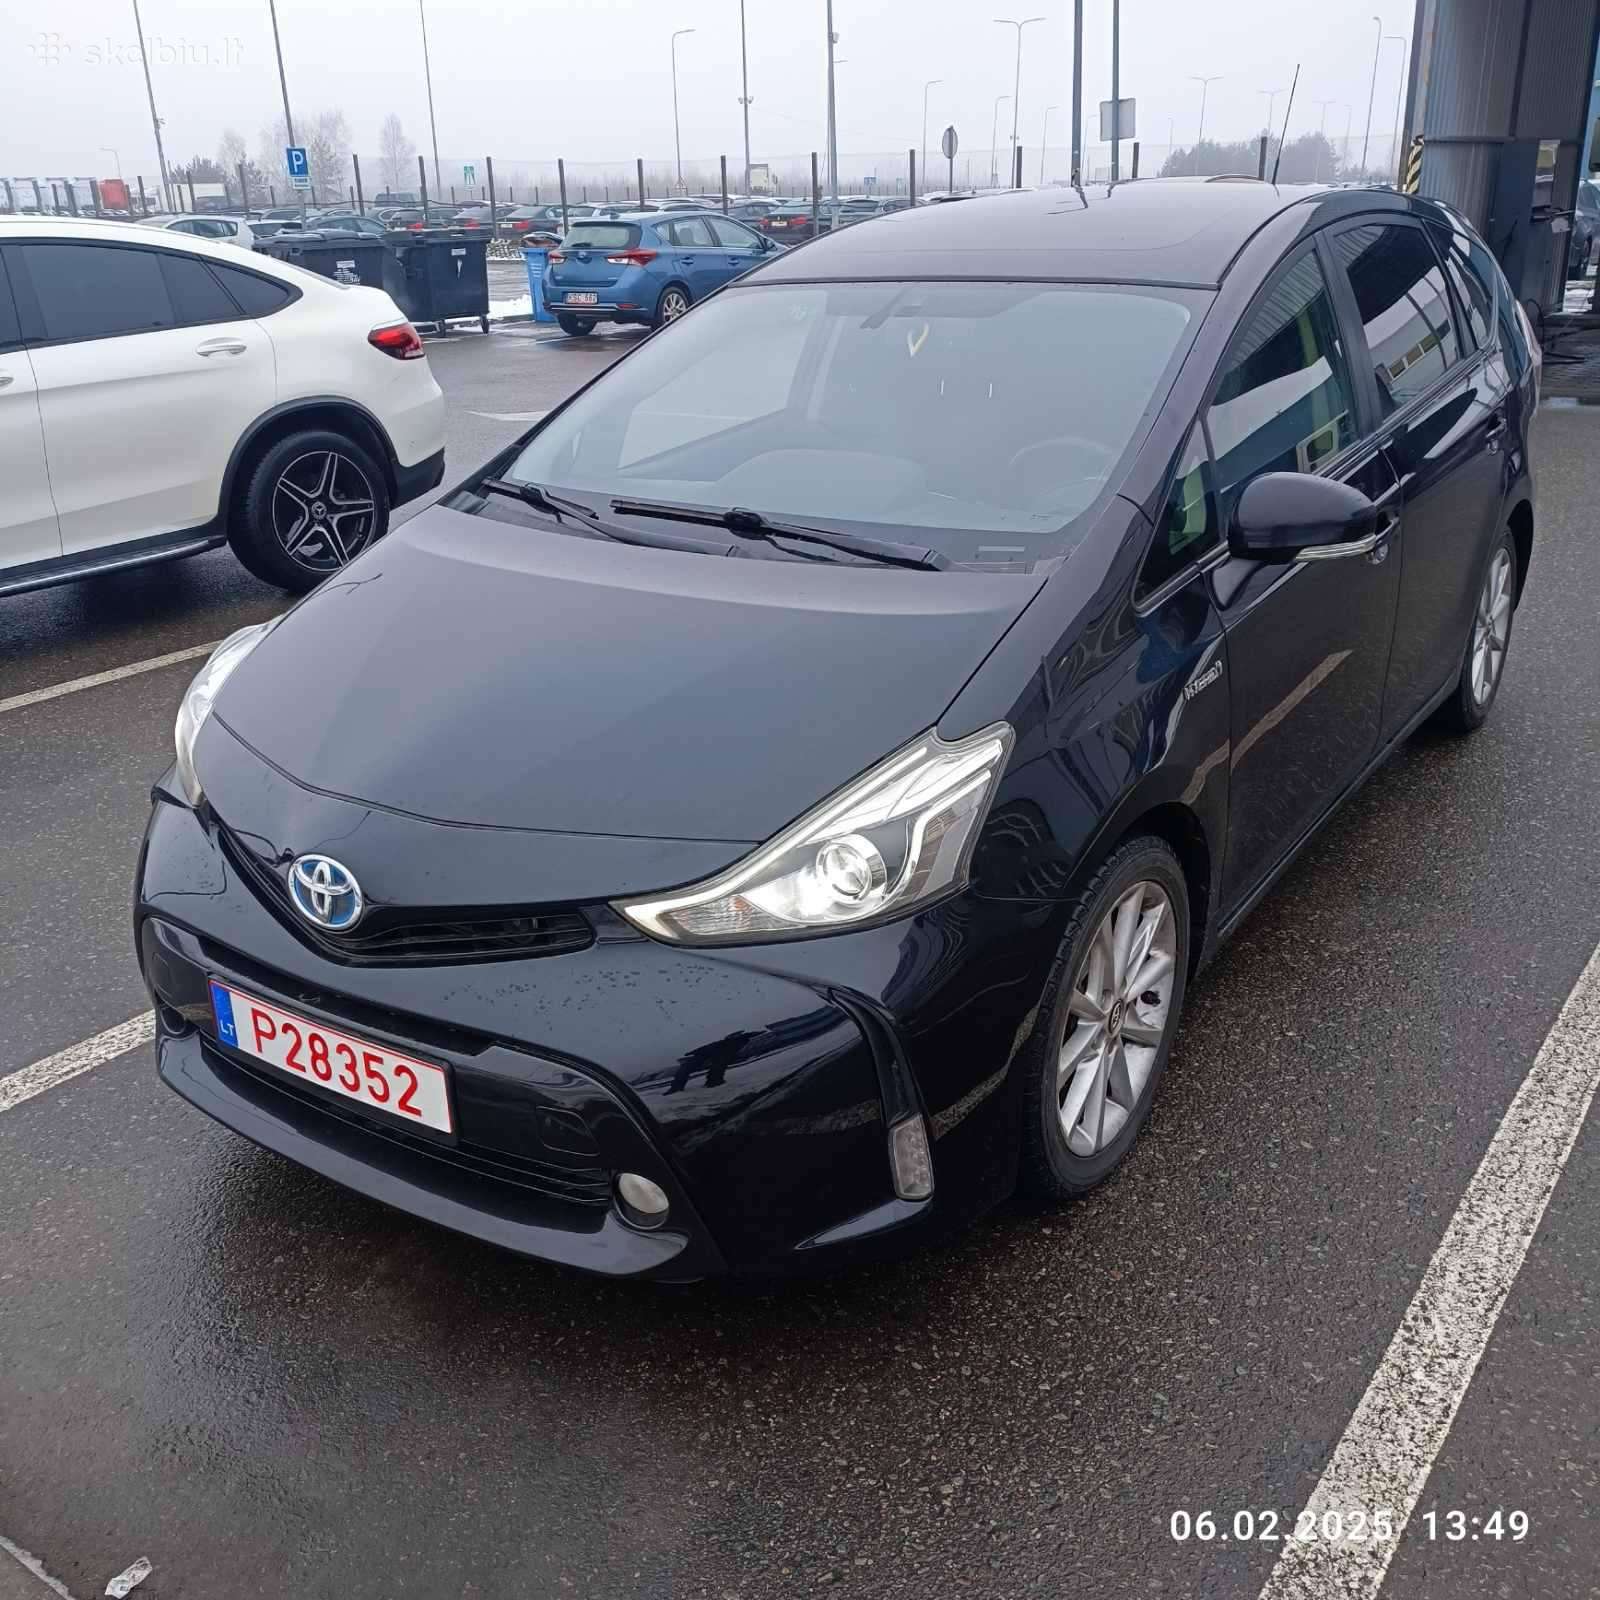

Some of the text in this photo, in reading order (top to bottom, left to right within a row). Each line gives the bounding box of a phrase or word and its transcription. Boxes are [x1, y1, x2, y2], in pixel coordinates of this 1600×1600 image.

[291, 150, 304, 173] P
[219, 1007, 422, 1117] LT P28352
